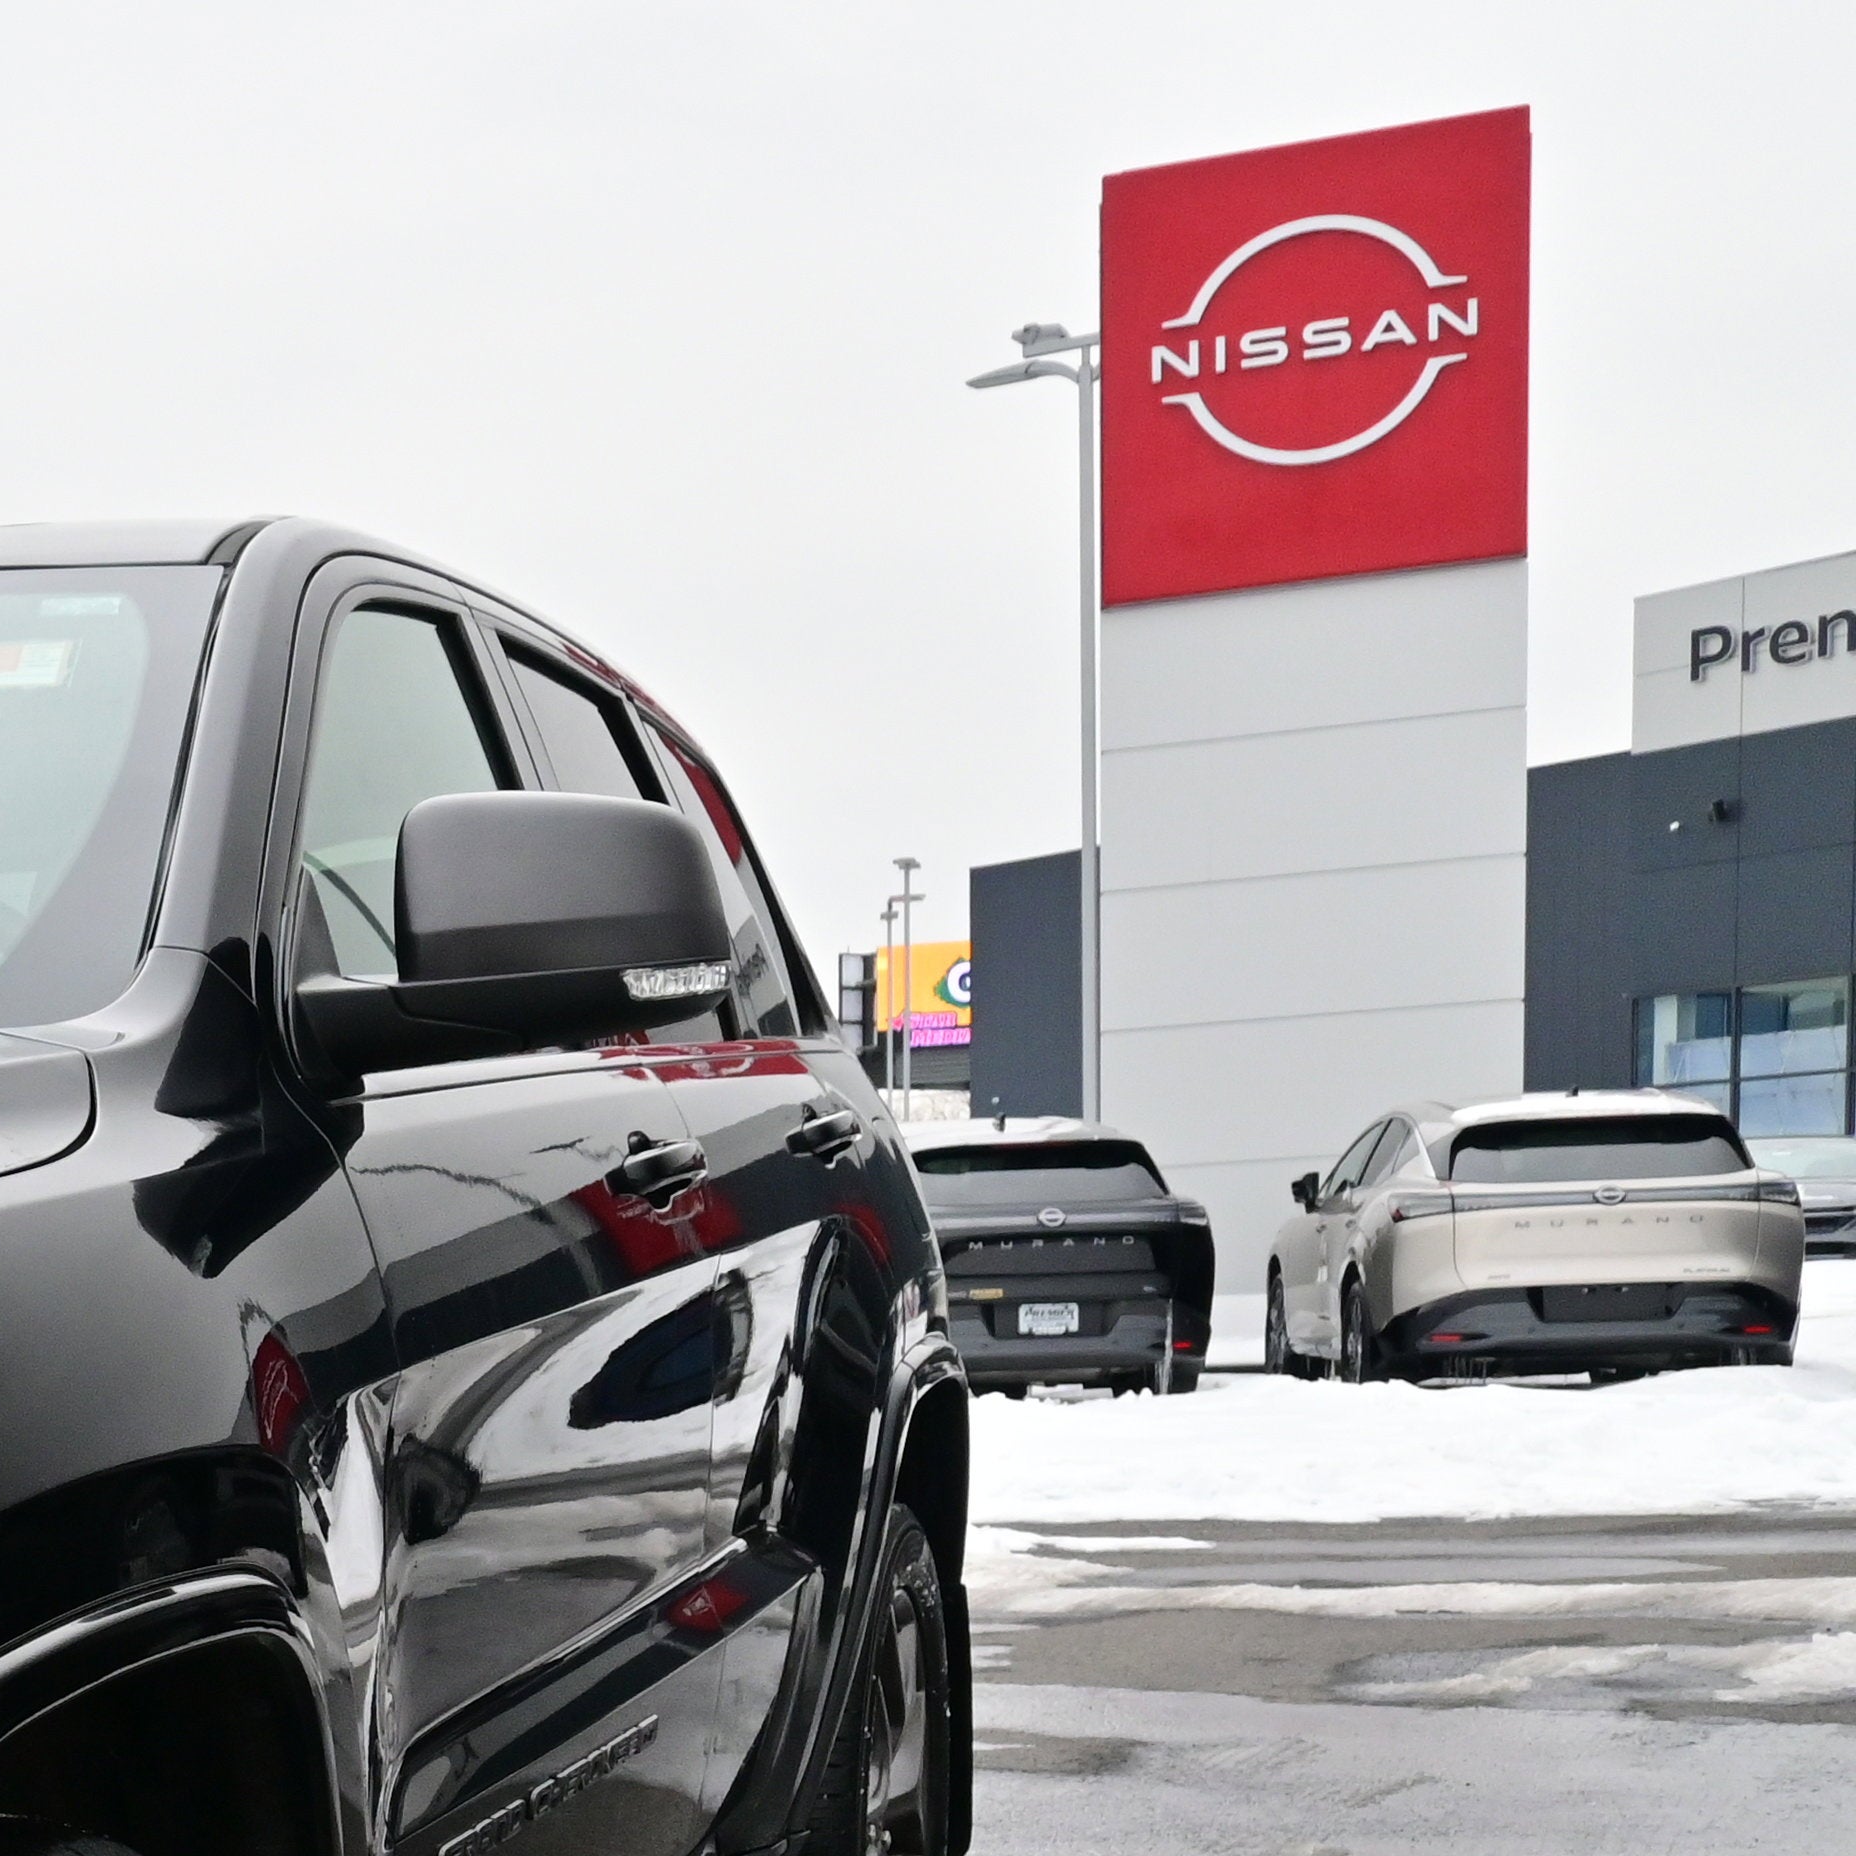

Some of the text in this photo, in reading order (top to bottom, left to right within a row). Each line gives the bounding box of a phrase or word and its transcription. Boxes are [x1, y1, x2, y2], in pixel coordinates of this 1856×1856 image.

[1151, 297, 1479, 384] NISSAN
[1515, 1215, 1704, 1229] MURANO
[969, 1235, 1135, 1250] MURANO
